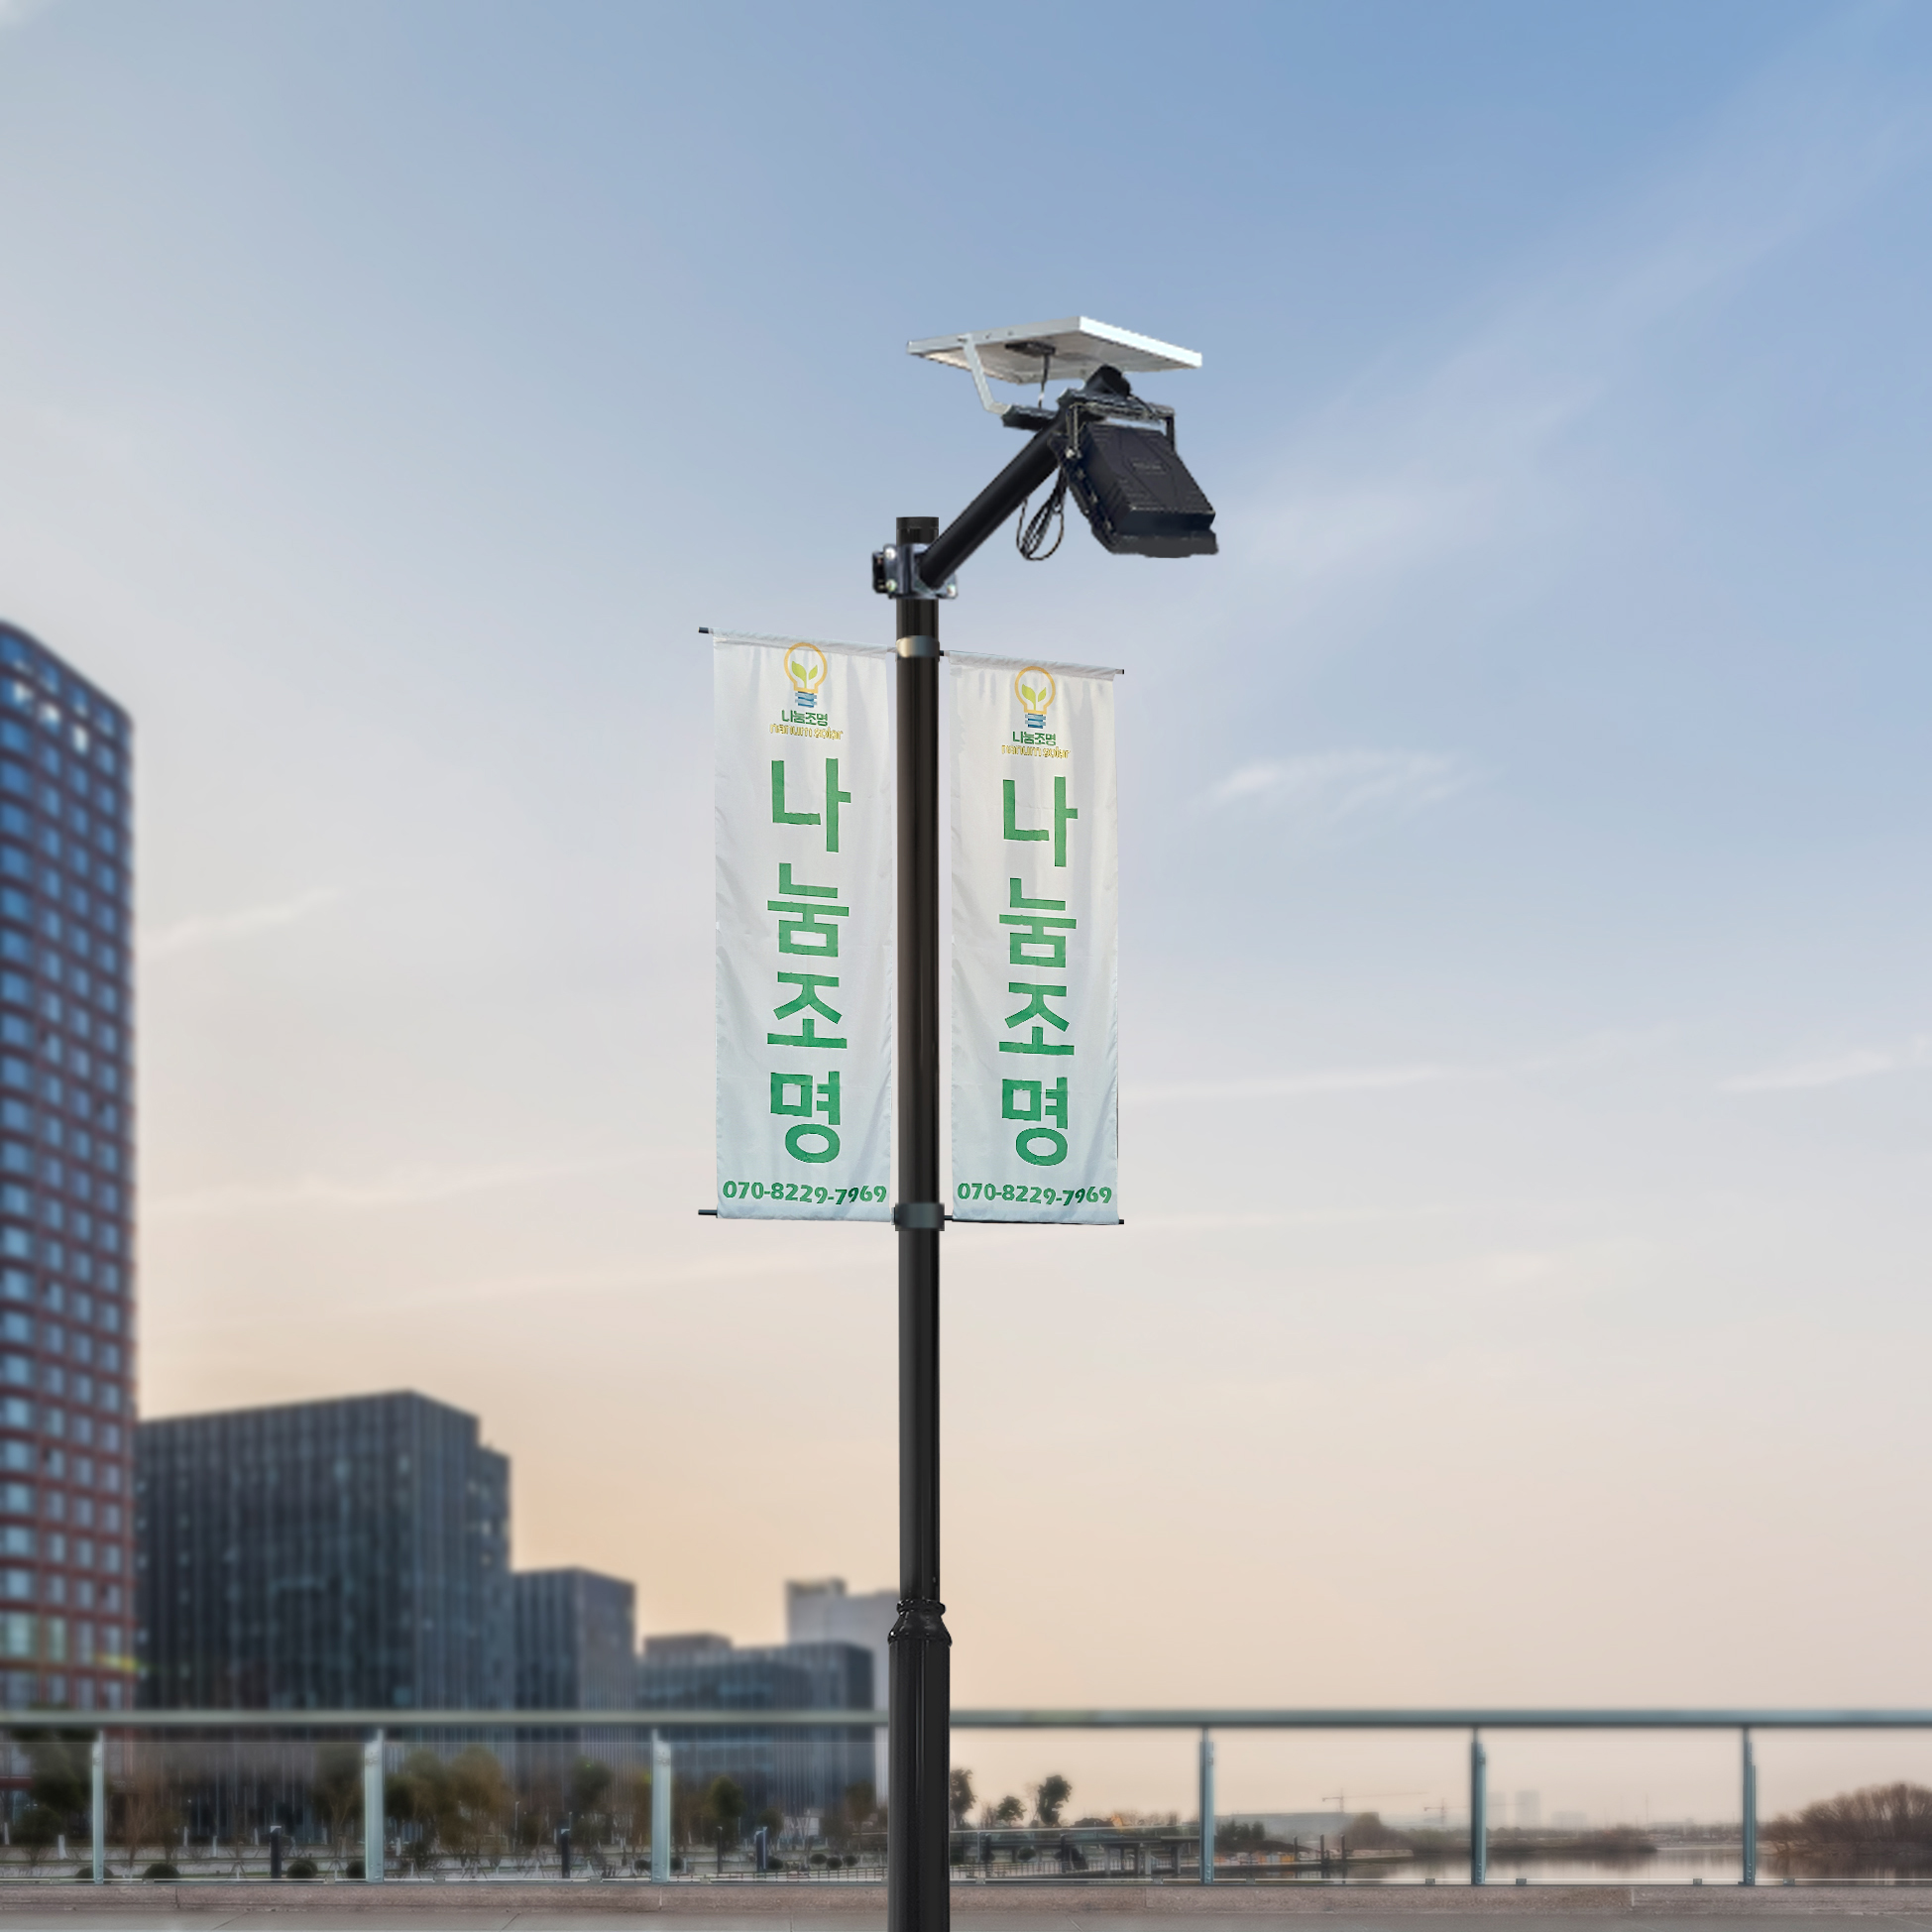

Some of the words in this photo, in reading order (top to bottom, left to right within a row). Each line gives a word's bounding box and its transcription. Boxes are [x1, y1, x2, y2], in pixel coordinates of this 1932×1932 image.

[781, 709, 828, 727] 나눔조명
[769, 723, 812, 738] nanum
[814, 727, 844, 740] solar
[1012, 731, 1056, 746] 나눔조명
[1001, 744, 1041, 757] nanum
[1043, 746, 1071, 759] solar
[766, 757, 852, 1164] 나눔조명
[998, 775, 1079, 1167] 나눔조명
[722, 1180, 887, 1205] 070-8229-7969
[957, 1183, 1112, 1206] 070-8229-7969
